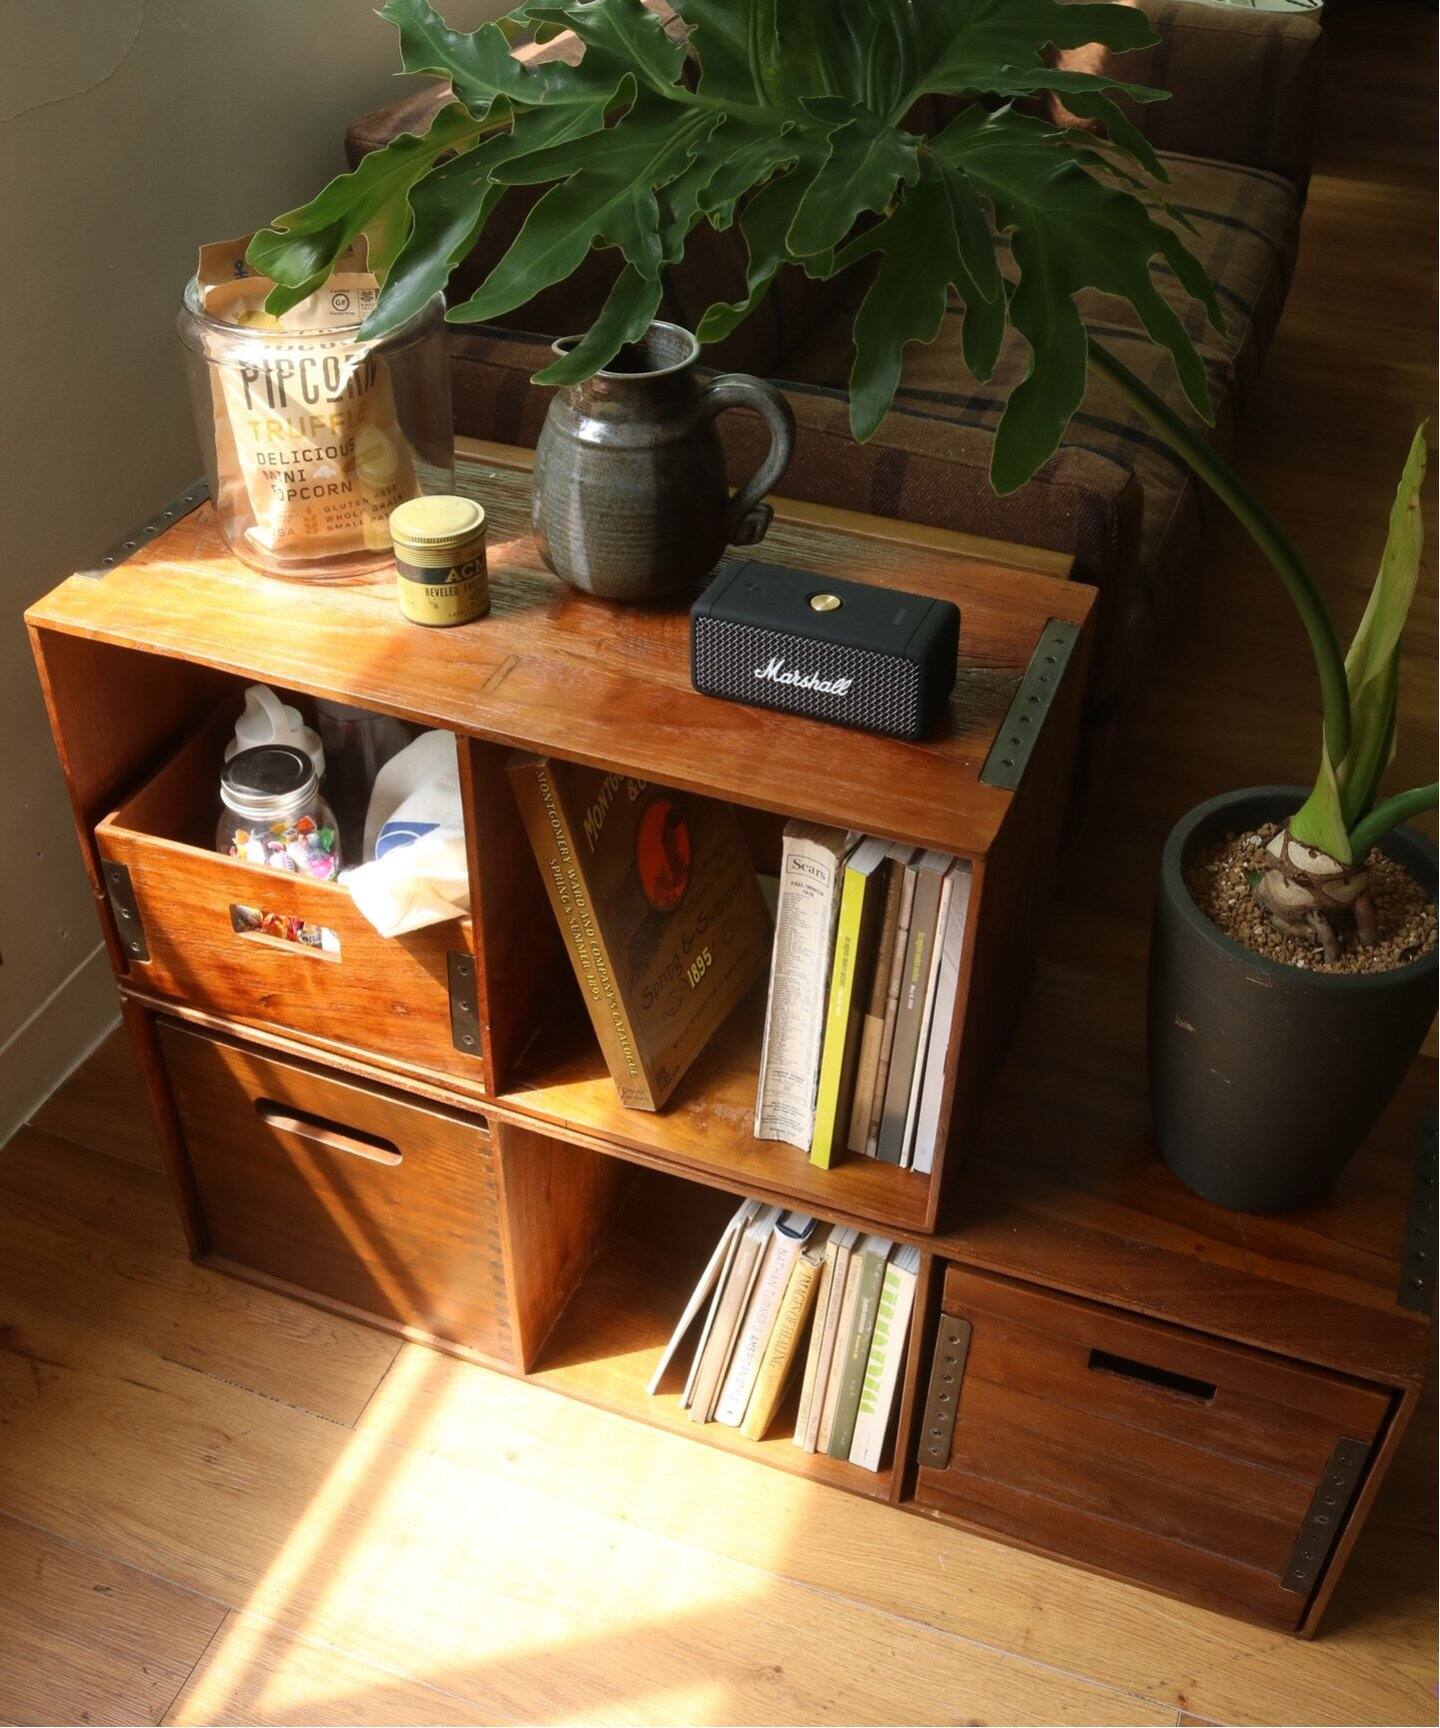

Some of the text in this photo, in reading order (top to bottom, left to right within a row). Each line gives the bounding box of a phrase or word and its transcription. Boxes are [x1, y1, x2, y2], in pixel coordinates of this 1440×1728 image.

[248, 403, 367, 444] TRUFFLE
[256, 438, 356, 467] DELICIOUS
[271, 480, 353, 503] POPCORN
[324, 497, 369, 513] GLUTEN
[425, 586, 459, 597] BEVELED
[755, 656, 851, 696] Marshall
[536, 769, 572, 865] MONTGOMERY
[567, 867, 586, 910] WARD
[580, 912, 595, 938] AND
[793, 859, 826, 880] Sears
[549, 858, 569, 904] SPRING
[687, 947, 713, 989] 1895
[767, 1248, 789, 1289] NATHAN
[790, 1271, 812, 1311] IMAGES
[786, 1308, 801, 1325] OF
[769, 1325, 797, 1369] HEALING
